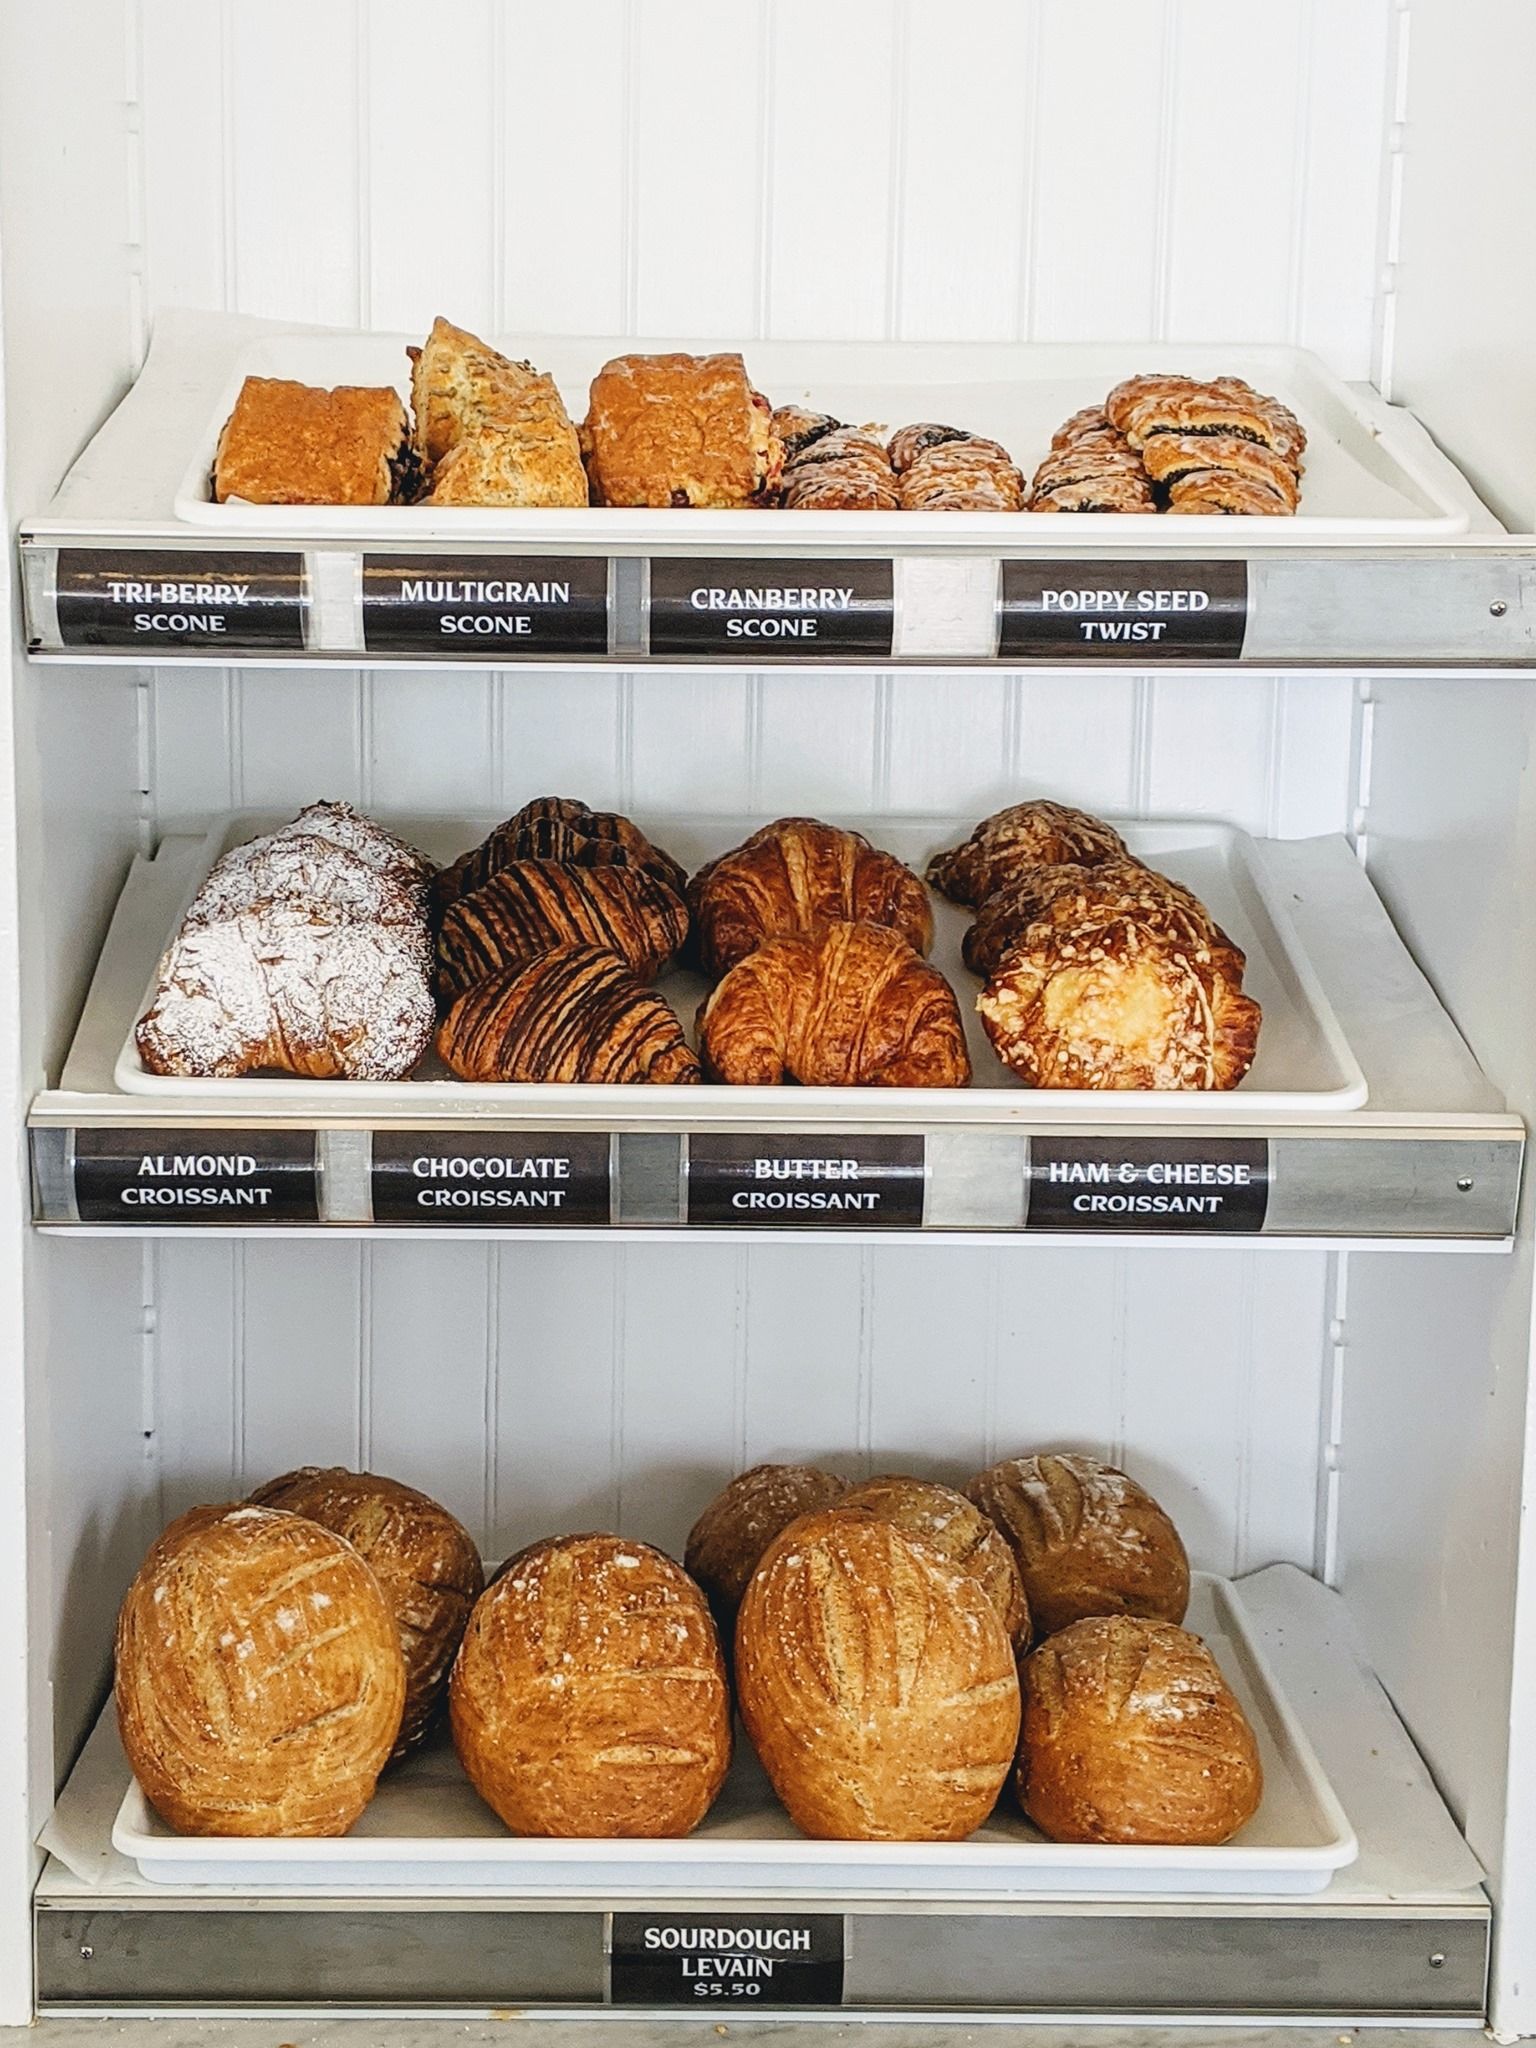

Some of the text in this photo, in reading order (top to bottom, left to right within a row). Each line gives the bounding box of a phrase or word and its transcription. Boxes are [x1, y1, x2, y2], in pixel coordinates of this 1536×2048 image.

[107, 581, 249, 606] TRI-BERRY
[400, 581, 570, 605] MULTIGRAIN
[689, 589, 854, 612] CRANBERRY
[1040, 590, 1209, 612] POPPY SEED
[134, 614, 227, 632] SCONE
[439, 616, 532, 634] SCONE
[726, 618, 817, 637] SCONE
[1081, 622, 1167, 641] TWIST
[137, 1156, 256, 1176] ALMOND
[411, 1157, 570, 1179] CHOCOLATE
[753, 1159, 860, 1179] BUTTER
[1048, 1163, 1251, 1185] HAM & CHEESE
[121, 1188, 272, 1205] CROISSANT
[417, 1190, 566, 1207] CROISSANT
[732, 1192, 881, 1210] CROISSANT
[1073, 1195, 1223, 1213] CROISSANT
[644, 1927, 811, 1950] SOURDOUGH
[682, 1955, 774, 1977] LEVAIN
[694, 1981, 761, 1996] $5.50
